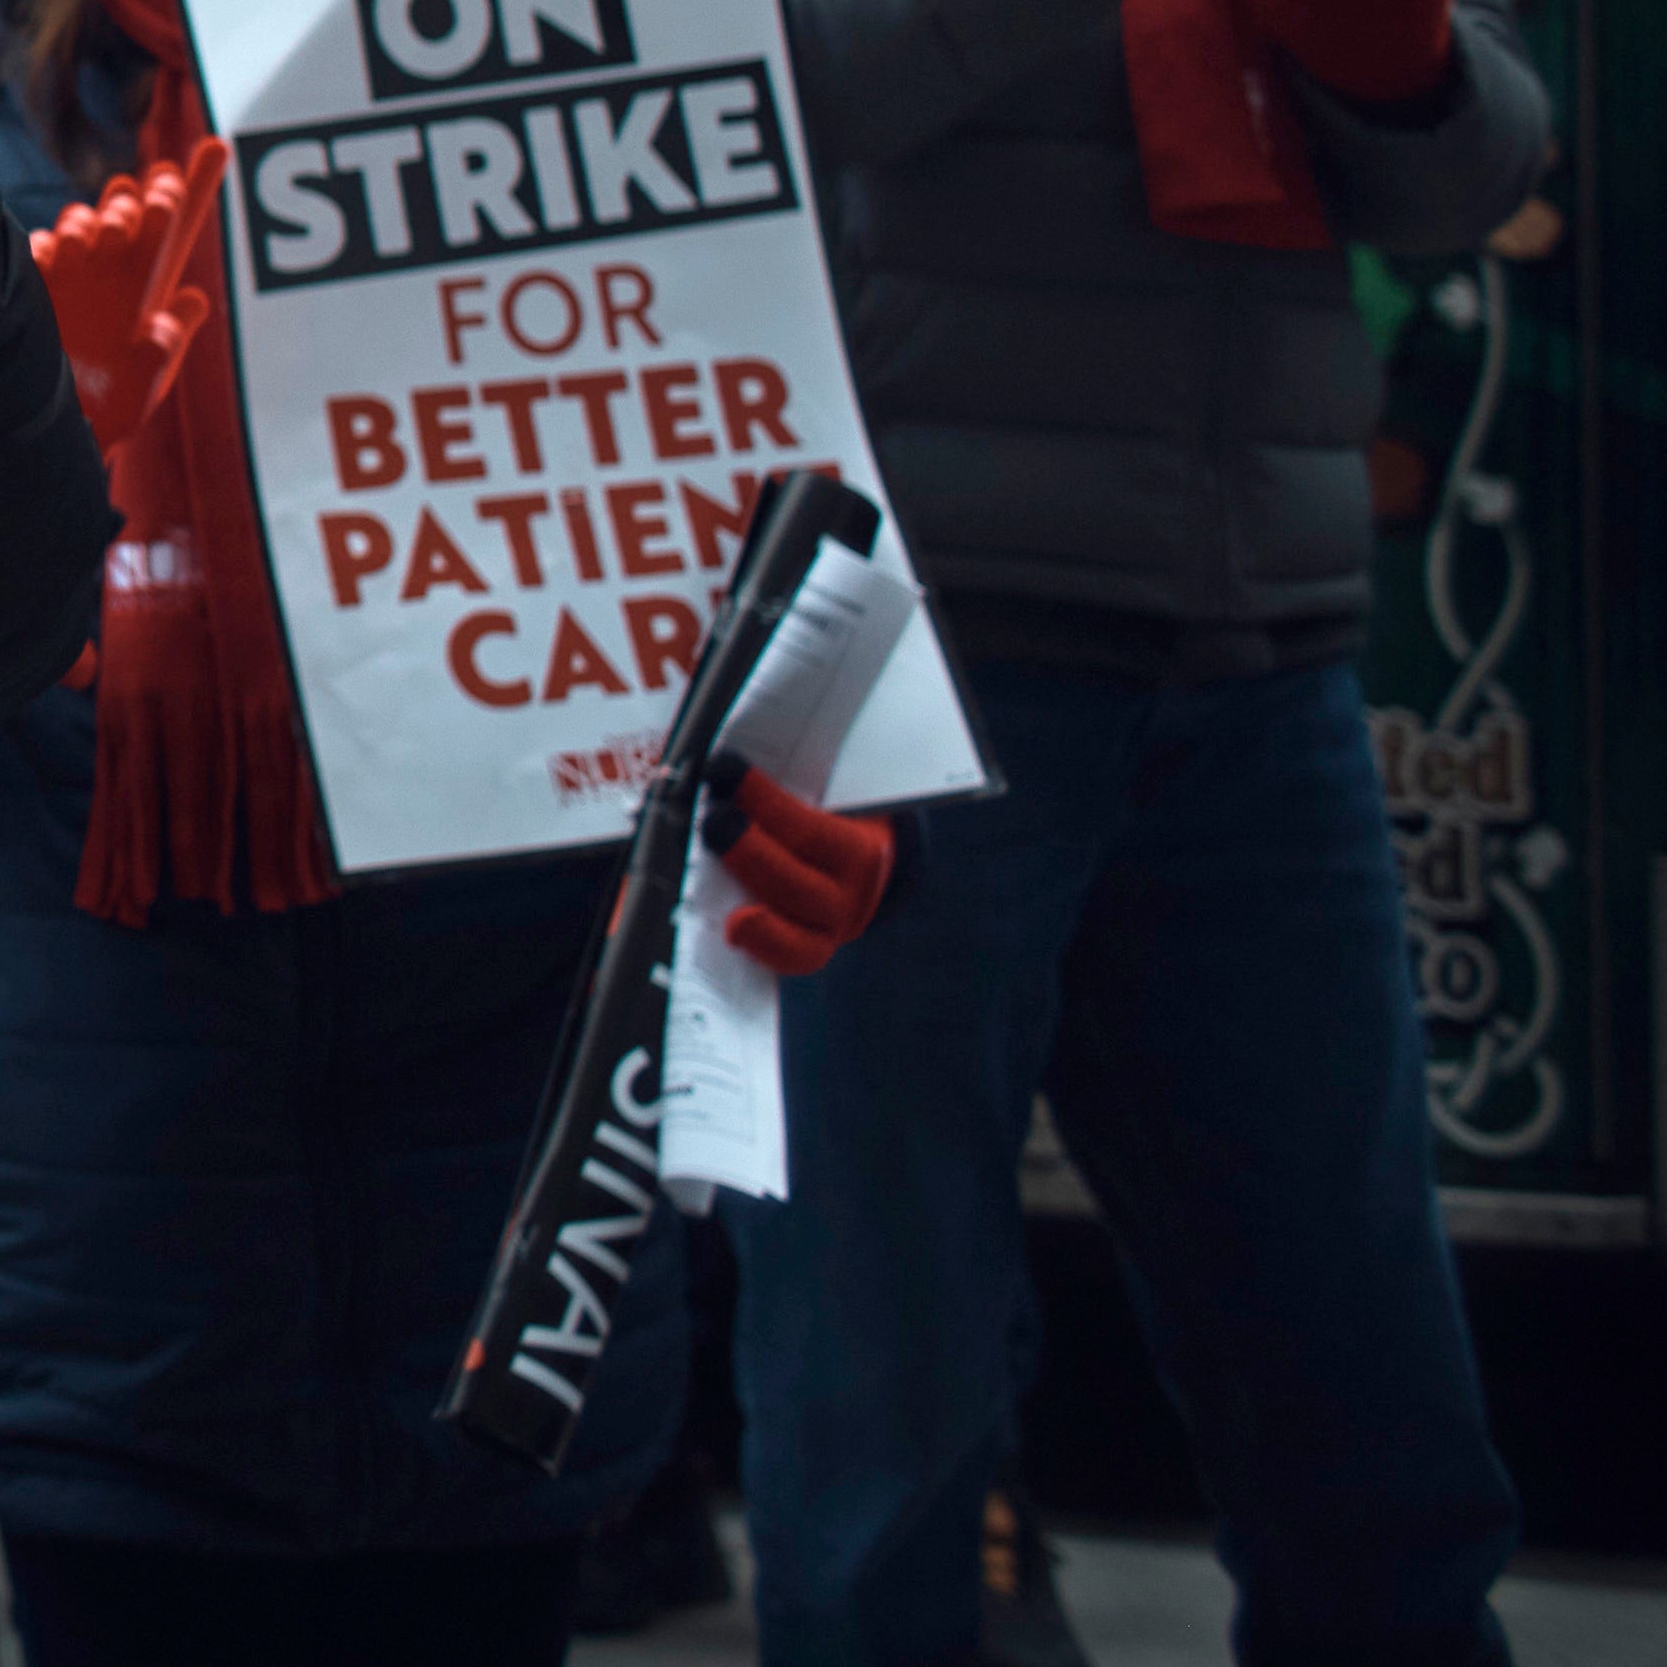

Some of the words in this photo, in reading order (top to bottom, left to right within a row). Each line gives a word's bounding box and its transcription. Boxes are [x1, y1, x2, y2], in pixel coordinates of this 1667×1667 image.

[254, 77, 779, 273] STRIKE
[436, 262, 663, 364] FOR
[324, 357, 800, 492] BETTER
[445, 590, 727, 713] CAR
[509, 1045, 666, 1415] SINAI
